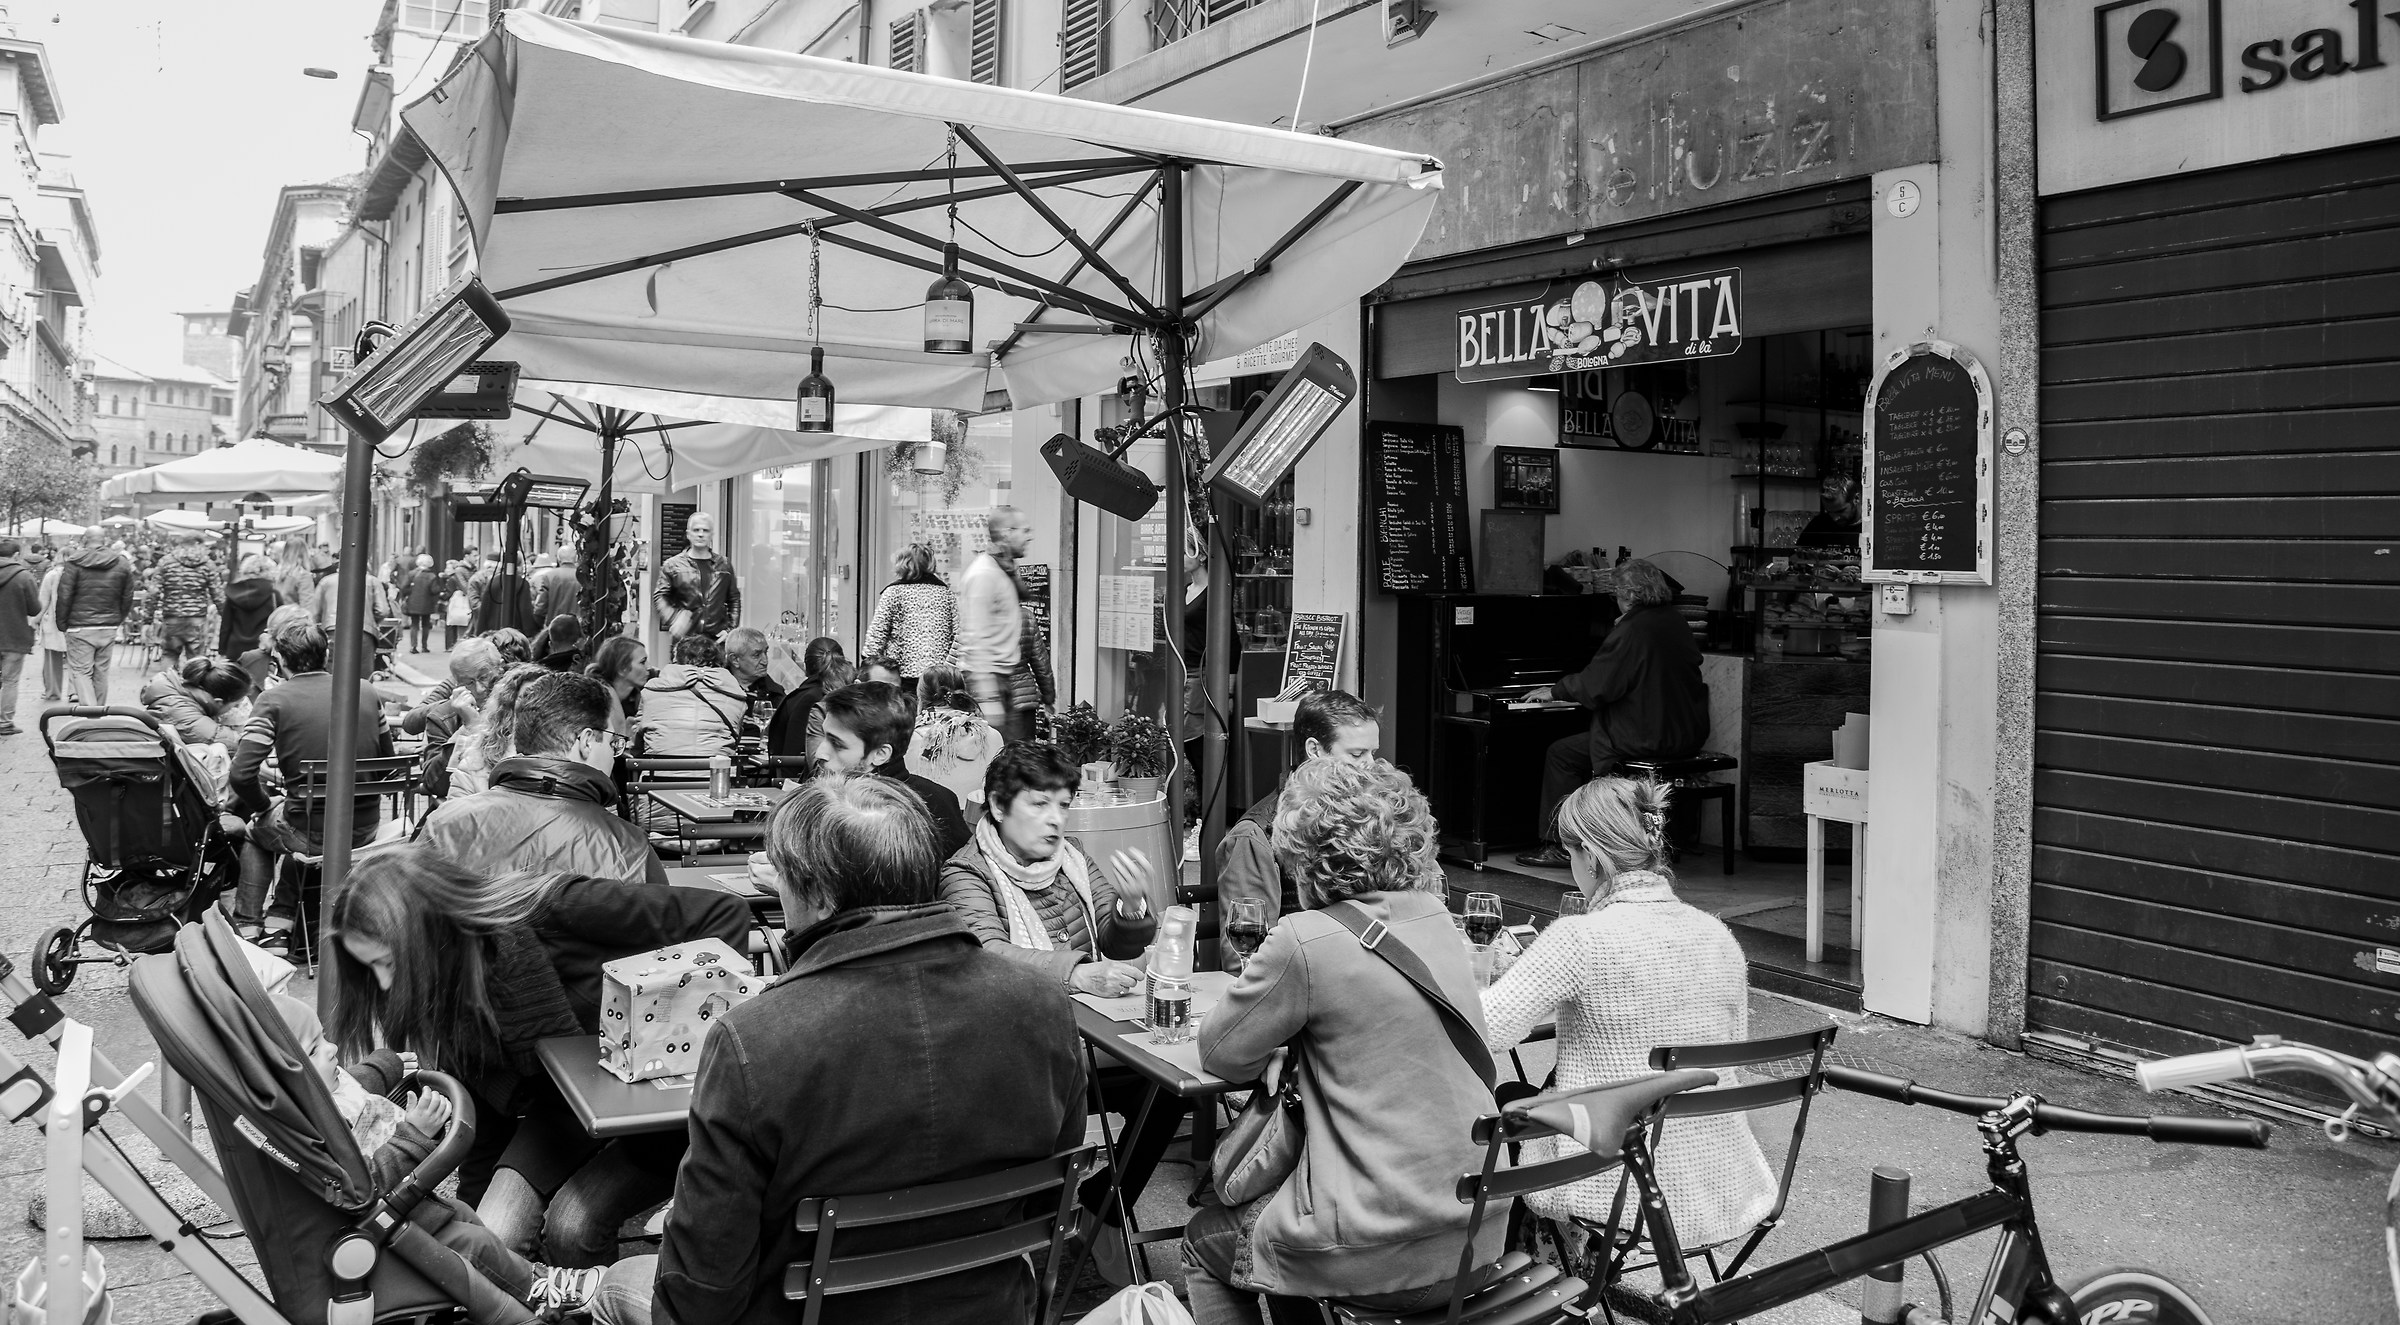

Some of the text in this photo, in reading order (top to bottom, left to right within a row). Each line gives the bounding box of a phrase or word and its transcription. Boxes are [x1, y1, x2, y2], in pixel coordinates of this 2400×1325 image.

[1899, 186, 1905, 198] S
[1898, 201, 1906, 213] C
[1459, 276, 1741, 368] BELLA VITA
[1684, 342, 1698, 356] di
[1243, 354, 1267, 368] RICETTE
[1270, 350, 1298, 365] GOURMET
[1577, 355, 1609, 369] BOLOGNA
[1564, 409, 1699, 443] BELLA VITA
[1922, 510, 1931, 521] €
[1924, 522, 1931, 531] €
[1920, 533, 1928, 542] €
[1919, 542, 1926, 551] €
[1919, 552, 1926, 561] €
[1819, 786, 1860, 797] MERLOTTA
